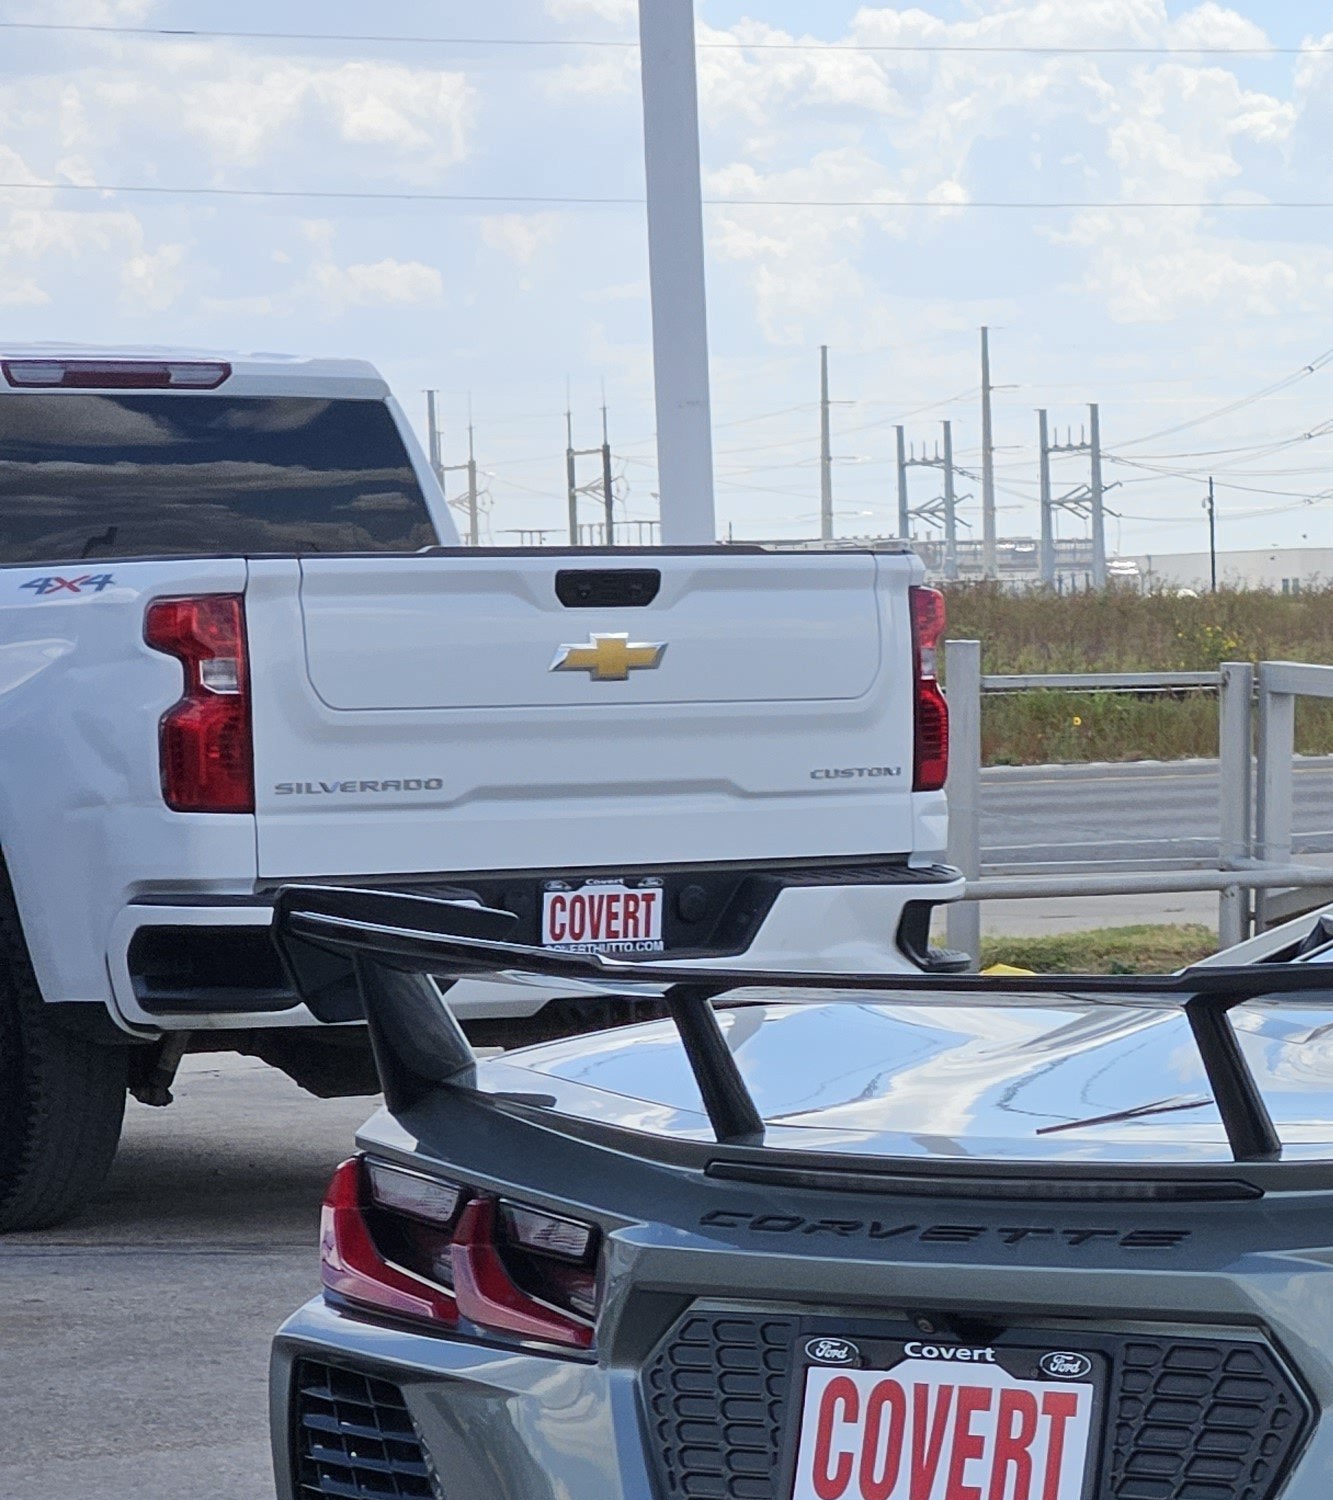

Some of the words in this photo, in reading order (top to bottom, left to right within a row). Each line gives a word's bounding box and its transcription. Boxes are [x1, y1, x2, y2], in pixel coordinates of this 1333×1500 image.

[809, 766, 901, 779] CUSTOM
[274, 778, 443, 795] SILVERADO
[549, 892, 656, 942] COVERT
[546, 941, 664, 954] ERTHUTTO.COM
[699, 1209, 1192, 1249] CORVETTE
[903, 1341, 996, 1362] Covert
